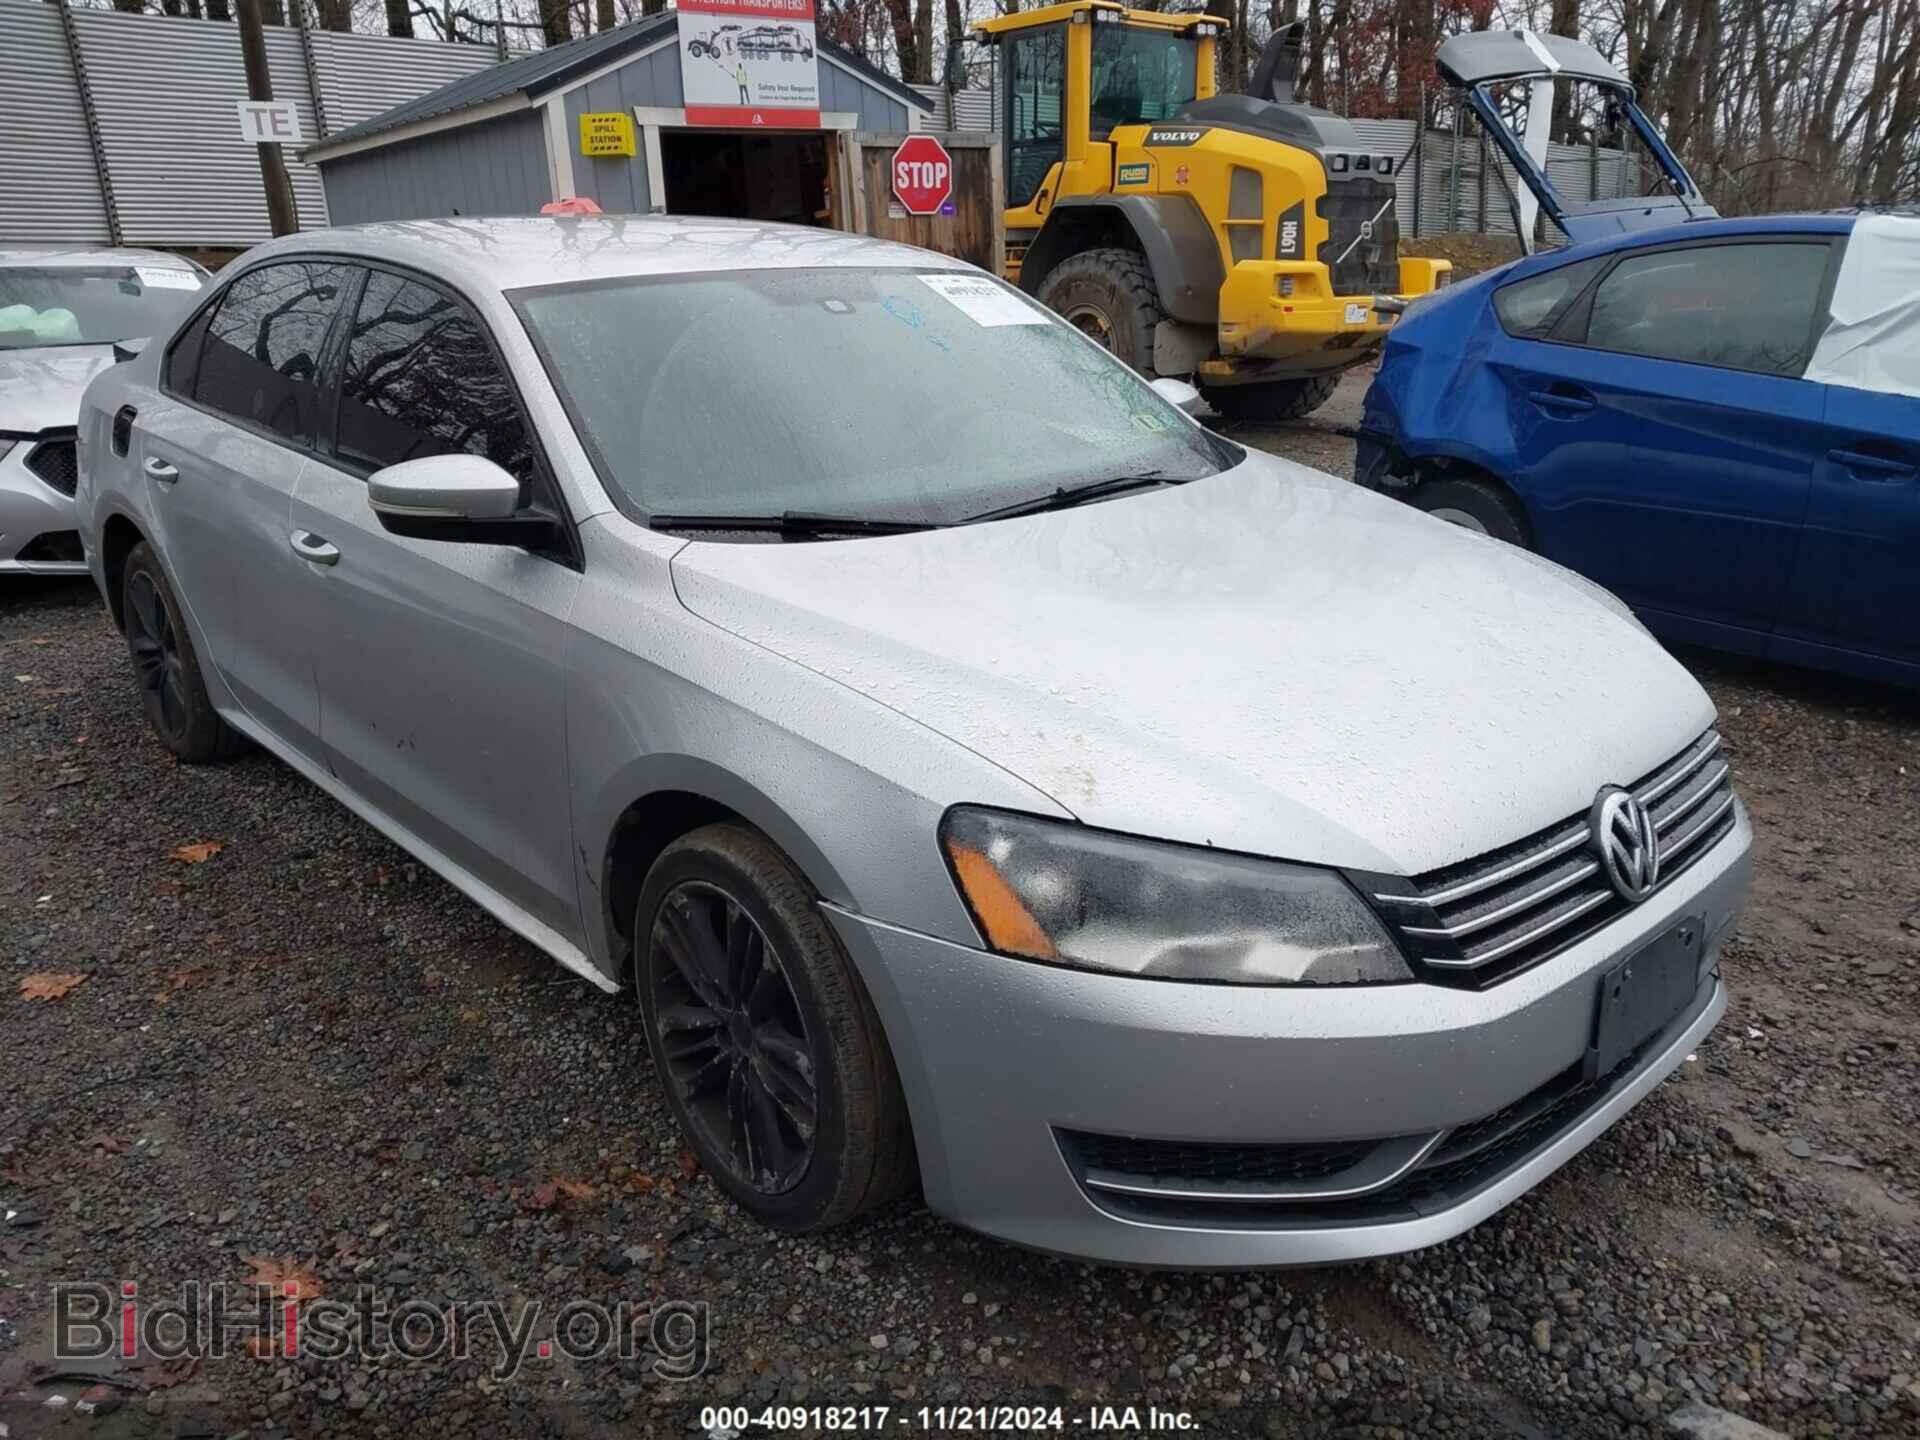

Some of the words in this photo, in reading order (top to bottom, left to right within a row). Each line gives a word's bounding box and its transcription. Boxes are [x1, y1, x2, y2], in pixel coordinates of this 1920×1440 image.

[246, 108, 292, 136] TE
[594, 125, 616, 133] SPILL
[590, 136, 622, 144] STATION
[1152, 132, 1199, 141] VOLVO
[897, 161, 947, 189] STOP
[1281, 221, 1298, 253] L90H
